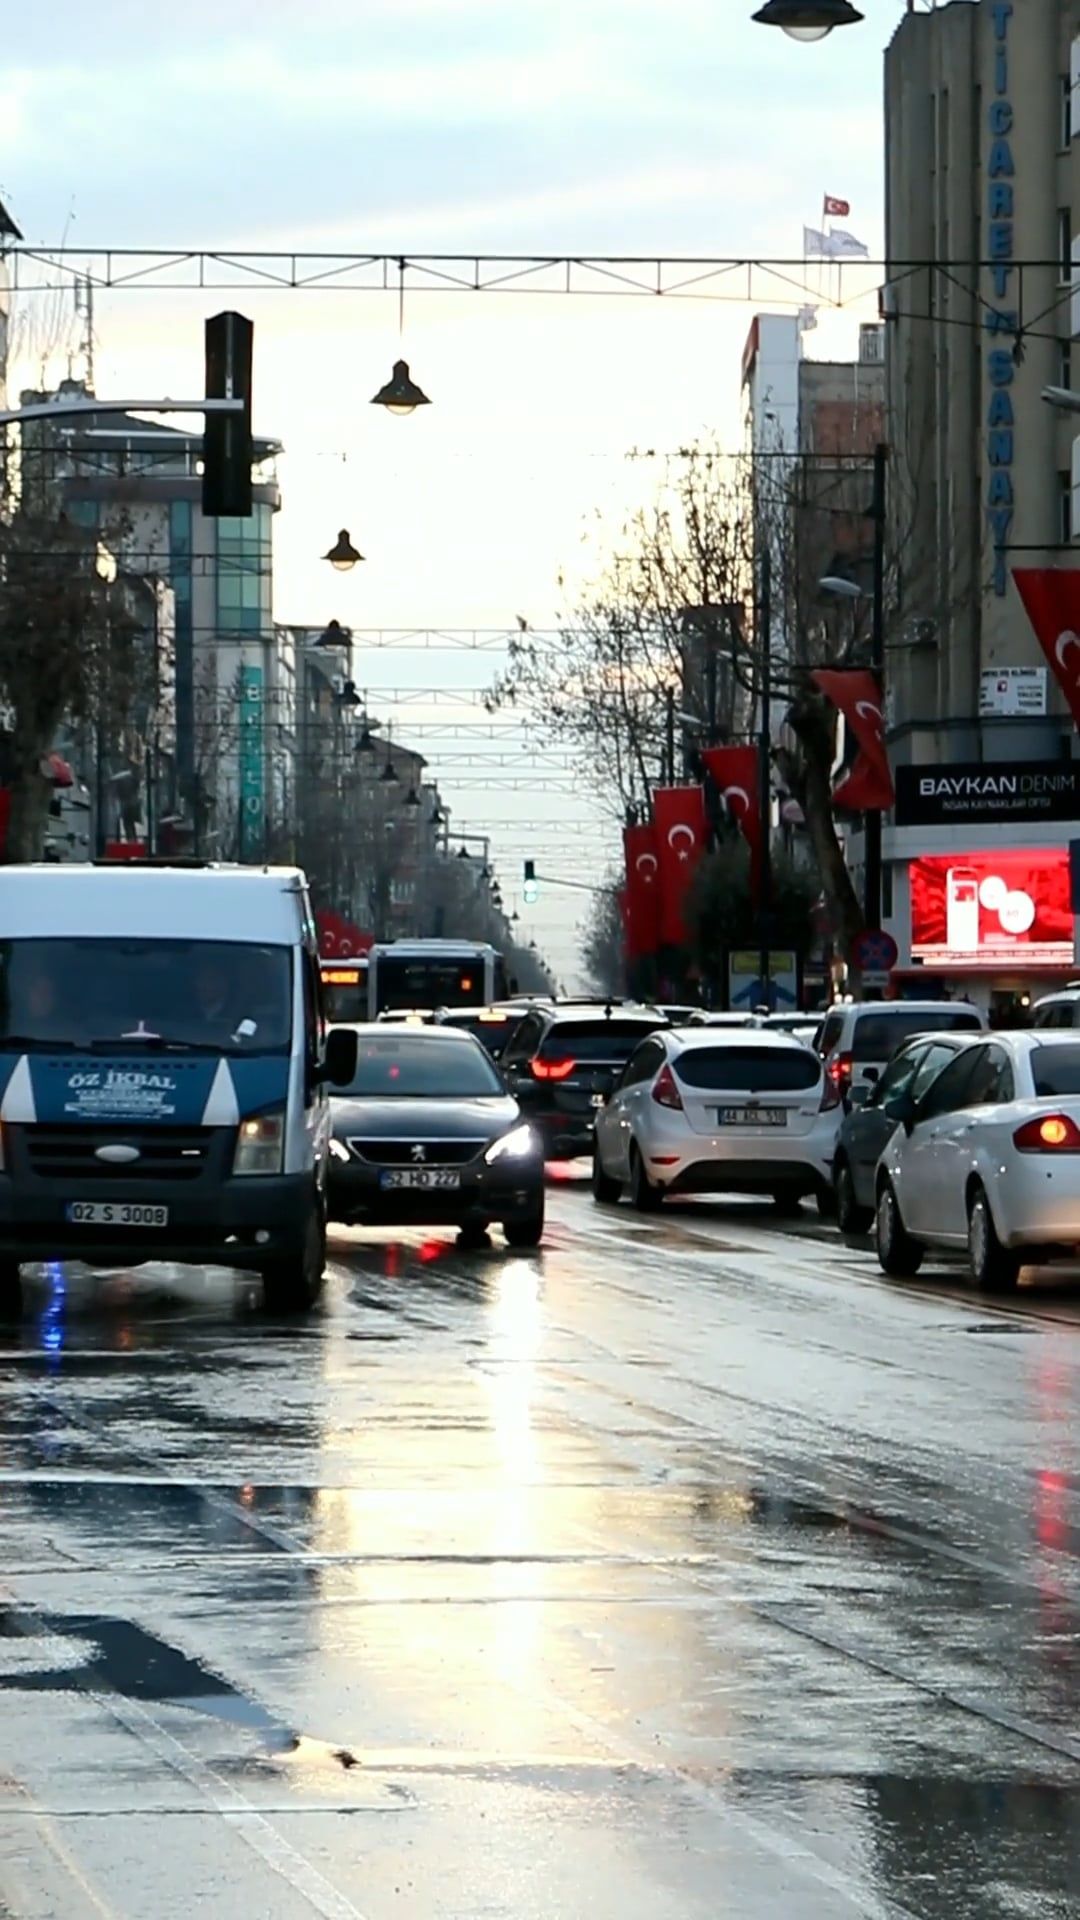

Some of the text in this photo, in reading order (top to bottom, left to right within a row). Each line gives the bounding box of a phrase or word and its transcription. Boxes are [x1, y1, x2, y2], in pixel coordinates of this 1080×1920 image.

[987, 0, 1015, 299] TİCARET
[919, 775, 1017, 796] BAYKAN
[103, 1069, 177, 1091] İKBAL
[73, 1204, 165, 1224] 02 S 3008
